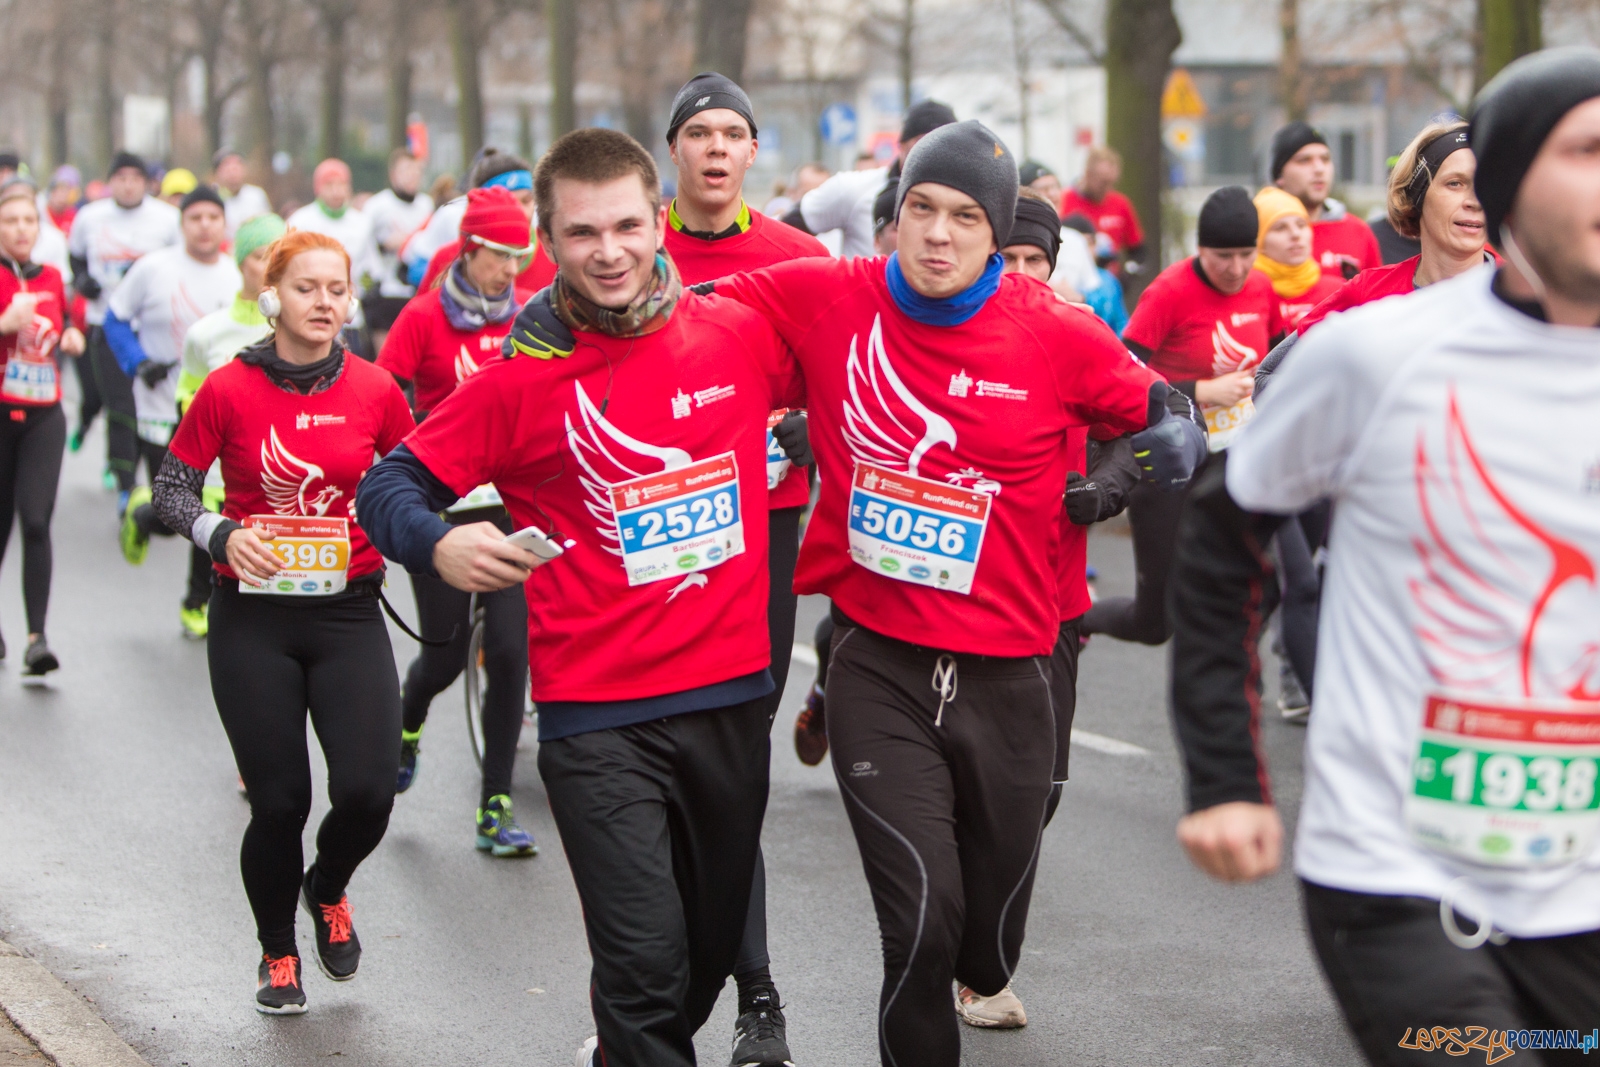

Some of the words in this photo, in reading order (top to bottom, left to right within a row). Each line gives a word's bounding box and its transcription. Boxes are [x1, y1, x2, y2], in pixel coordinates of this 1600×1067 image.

[685, 467, 733, 486] RunPoland.org
[623, 527, 636, 540] E
[638, 492, 734, 547] 2528
[922, 491, 979, 513] RunPoland.org
[300, 526, 341, 535] RunPoland.org
[852, 504, 861, 517] E
[862, 500, 967, 555] 5056
[1441, 749, 1598, 812] 1938
